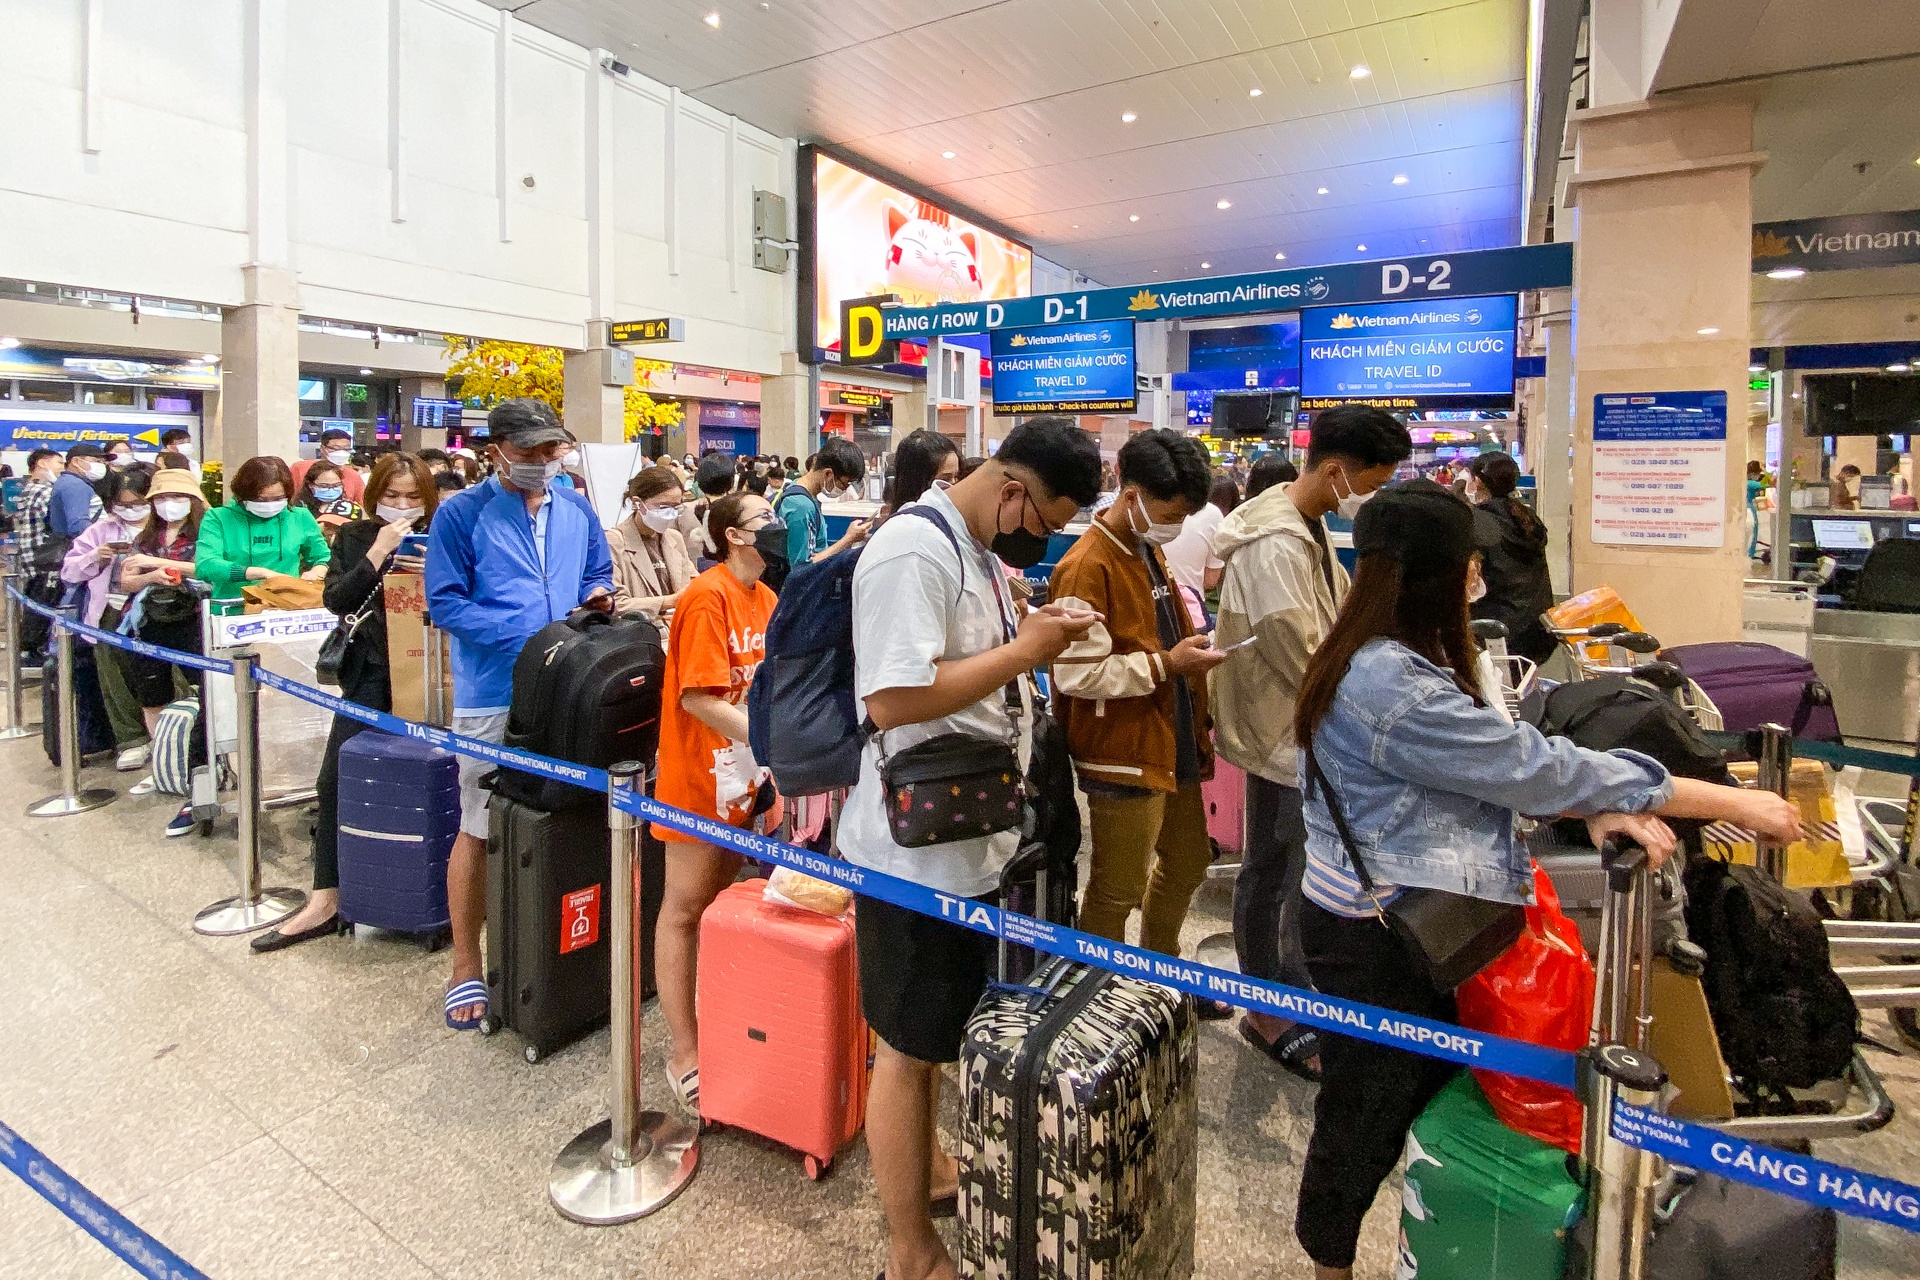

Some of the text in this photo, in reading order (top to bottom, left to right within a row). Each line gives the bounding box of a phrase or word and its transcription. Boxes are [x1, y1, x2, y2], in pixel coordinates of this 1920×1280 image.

[1795, 230, 1920, 254] Vietnam
[1382, 260, 1451, 294] D-2
[1160, 283, 1301, 309] Vietnam Airlines
[886, 304, 1005, 332] HÀNG / ROW D
[1043, 295, 1088, 323] D-1
[1355, 312, 1460, 328] Vietnam Airlines
[850, 306, 883, 358] D
[1026, 332, 1097, 346] Vietnam Airlines
[1310, 337, 1504, 360] KHÁCH MIỄN GIẢM CƯỚC
[998, 352, 1127, 371] KHÁCH MIỄN GIẢM CƯỚC
[1034, 375, 1086, 388] TRAVEL ID
[1364, 365, 1442, 379] TRAVEL ID
[1059, 402, 1088, 410] Check-in
[1088, 401, 1120, 410] counters
[1120, 400, 1134, 409] will
[1312, 399, 1343, 408] before
[1392, 398, 1418, 407] time.
[12, 426, 130, 441] Vietravel Airlines
[706, 440, 736, 450] VASCO
[404, 721, 426, 740] TIA
[500, 750, 554, 773] INTERNATIONAL
[553, 765, 588, 781] AIRPORT
[697, 820, 732, 842] KHÔNG
[733, 833, 763, 853] QUỐC
[765, 842, 780, 858] TẾ
[781, 848, 803, 866] TÂN
[805, 856, 831, 876] SƠN
[832, 866, 864, 886] NHẤT
[934, 893, 996, 931] TIA
[1005, 913, 1019, 923] TAN
[1004, 930, 1035, 944] AIRPORT
[1076, 939, 1484, 1058] TAN SON NHAT INTERNATIONAL AIRPORT
[1647, 1113, 1686, 1133] NHAT
[1710, 1142, 1920, 1219] CẢNG HÀNG
